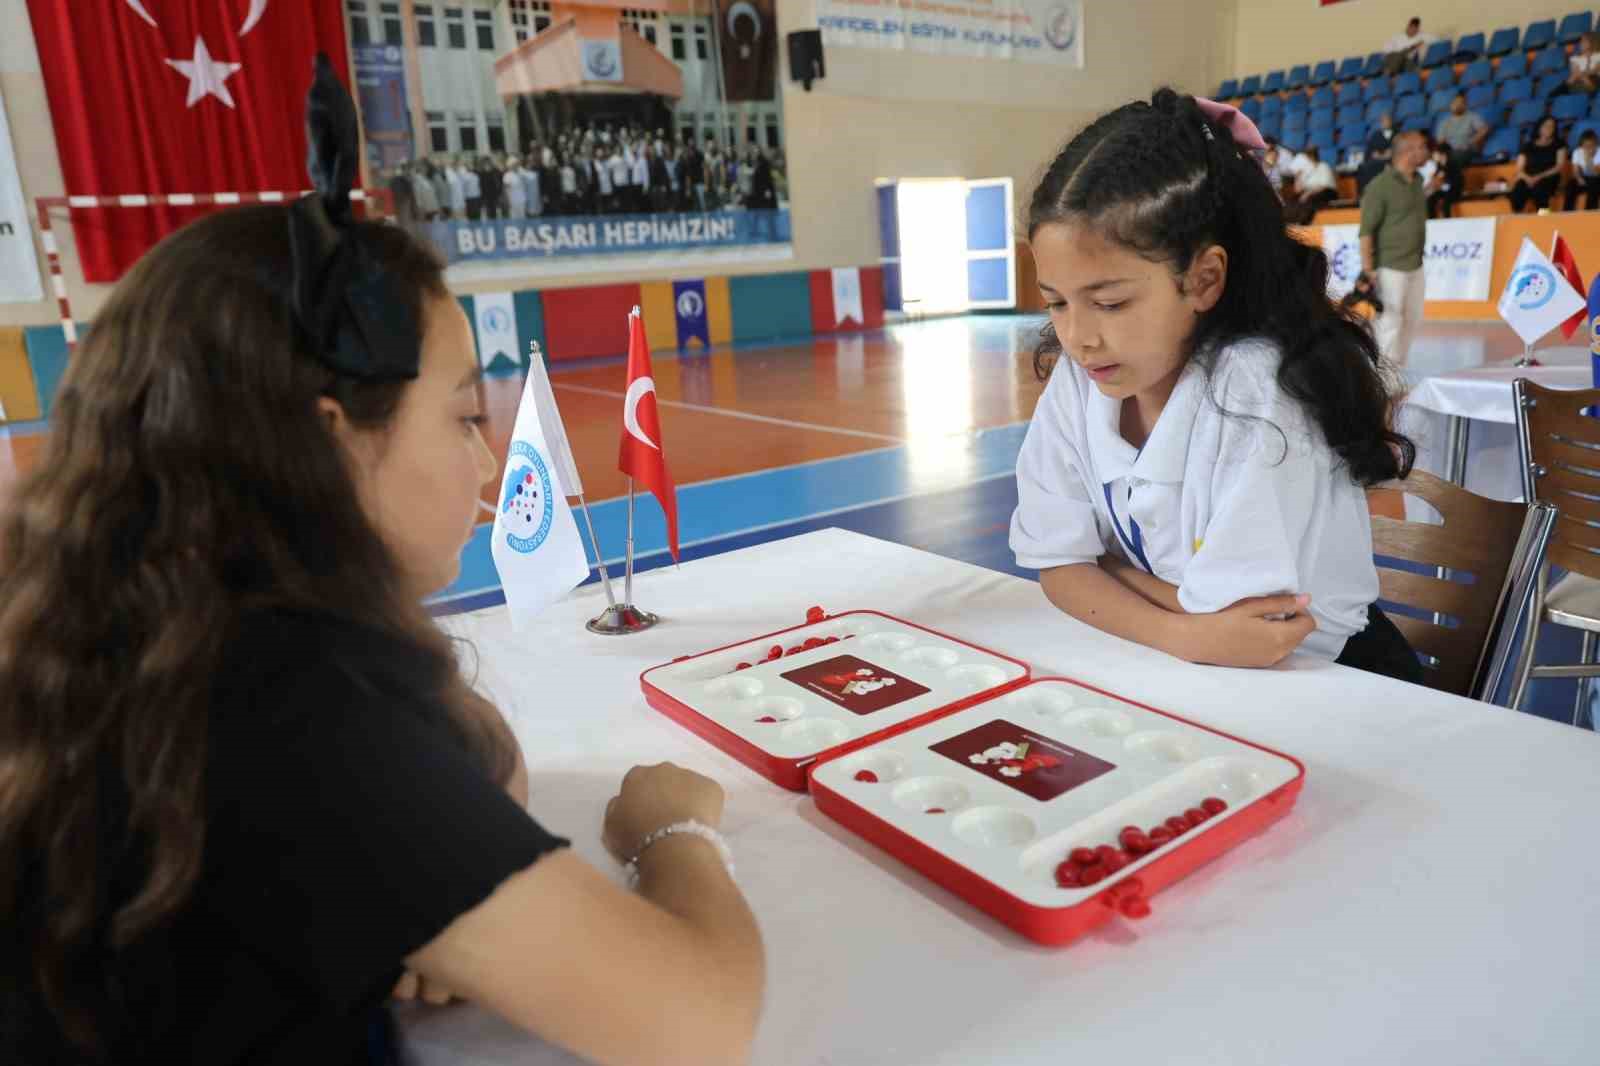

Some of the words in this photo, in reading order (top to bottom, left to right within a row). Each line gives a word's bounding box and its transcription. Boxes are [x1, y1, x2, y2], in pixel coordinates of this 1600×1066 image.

[457, 228, 496, 253] BU
[504, 222, 595, 254] BAŞARI
[603, 216, 736, 247] HEPİMİZİN!
